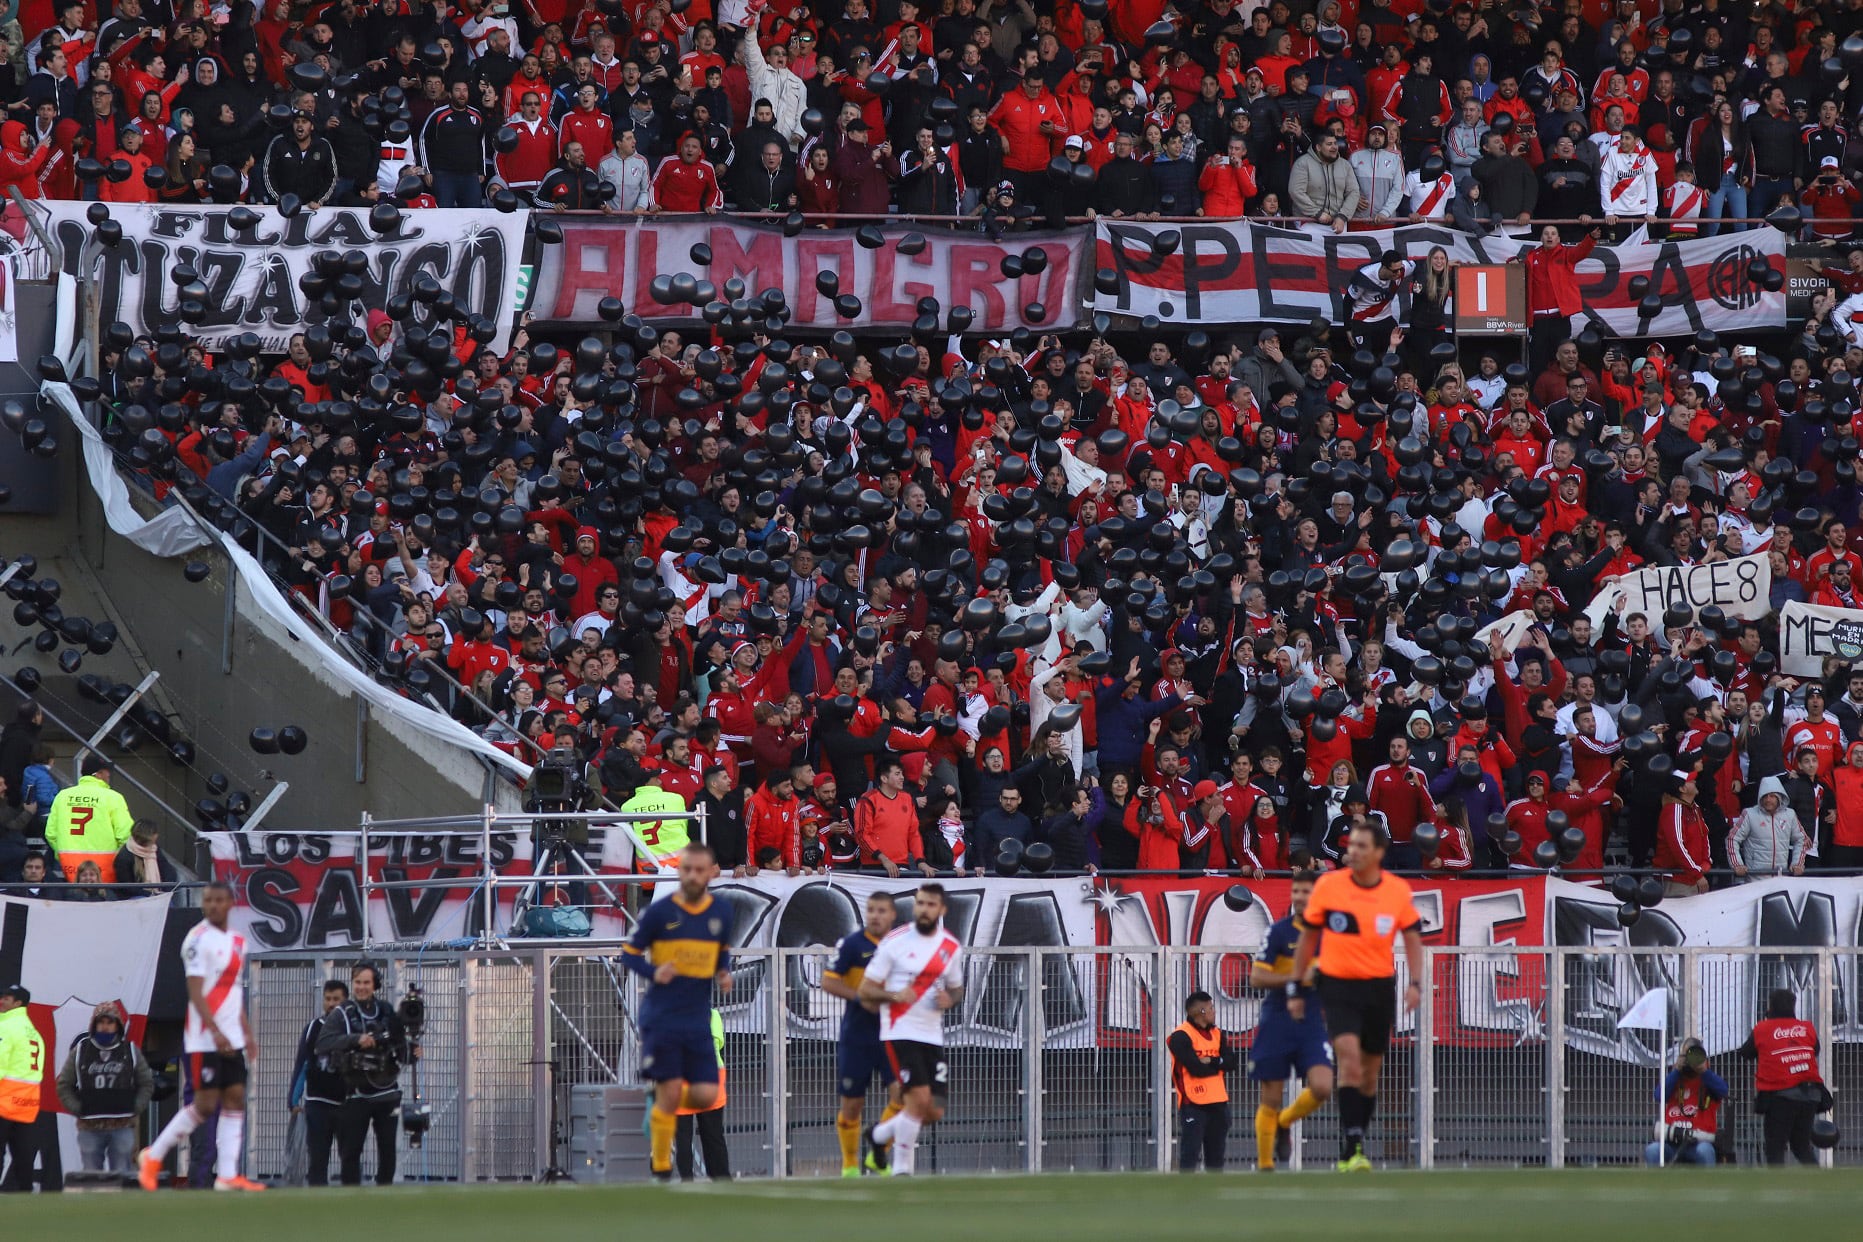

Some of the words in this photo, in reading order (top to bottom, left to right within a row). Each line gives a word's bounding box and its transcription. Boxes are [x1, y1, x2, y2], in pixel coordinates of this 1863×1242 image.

[150, 210, 425, 248] FILIAL
[552, 226, 1070, 328] ALMAGRO
[1486, 321, 1507, 329] BBVA
[1507, 321, 1525, 329] River
[1640, 562, 1734, 611] HACE
[1736, 560, 1759, 603] 8
[68, 795, 99, 804] TECH
[633, 803, 665, 813] TECH
[230, 832, 332, 868] LOS
[355, 834, 517, 867] PIBES
[95, 1074, 117, 1089] 07
